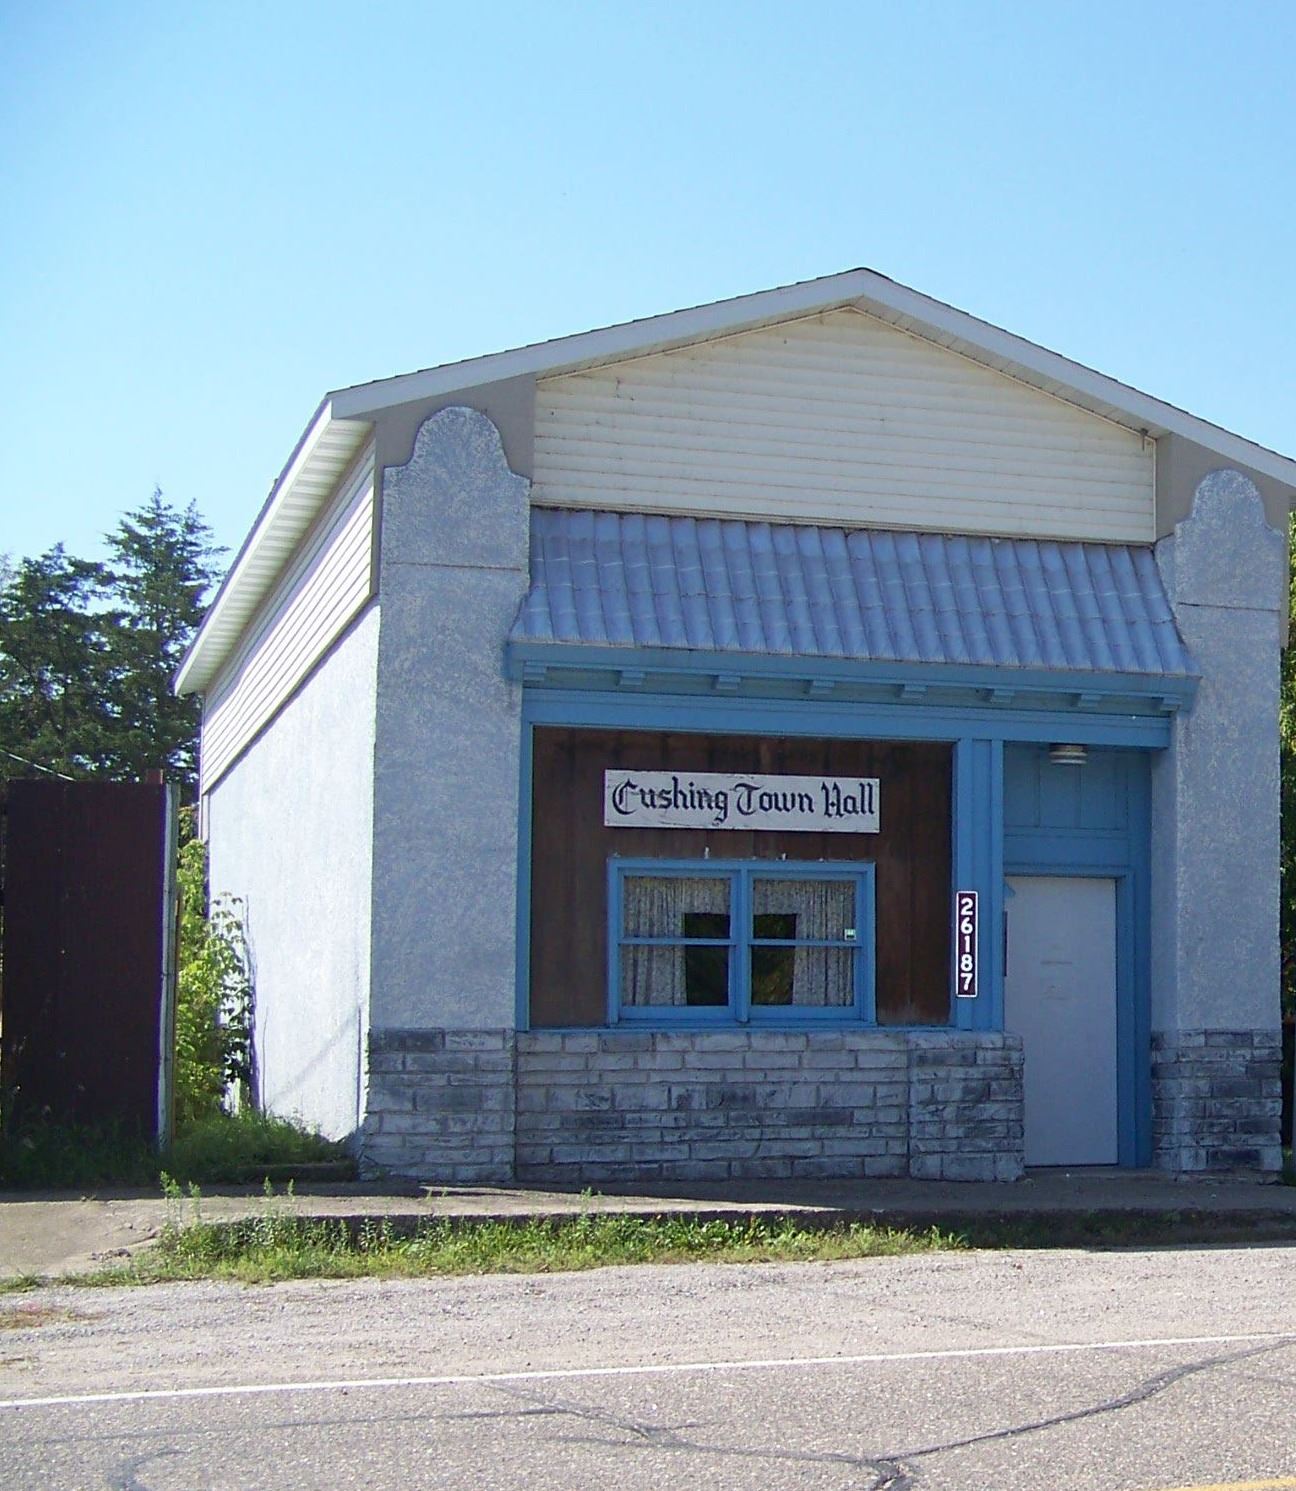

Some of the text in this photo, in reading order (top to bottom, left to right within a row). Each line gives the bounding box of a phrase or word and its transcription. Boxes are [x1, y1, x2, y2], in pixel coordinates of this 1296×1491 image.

[612, 776, 876, 824] Cushing Town Hall
[960, 897, 974, 991] 26187
